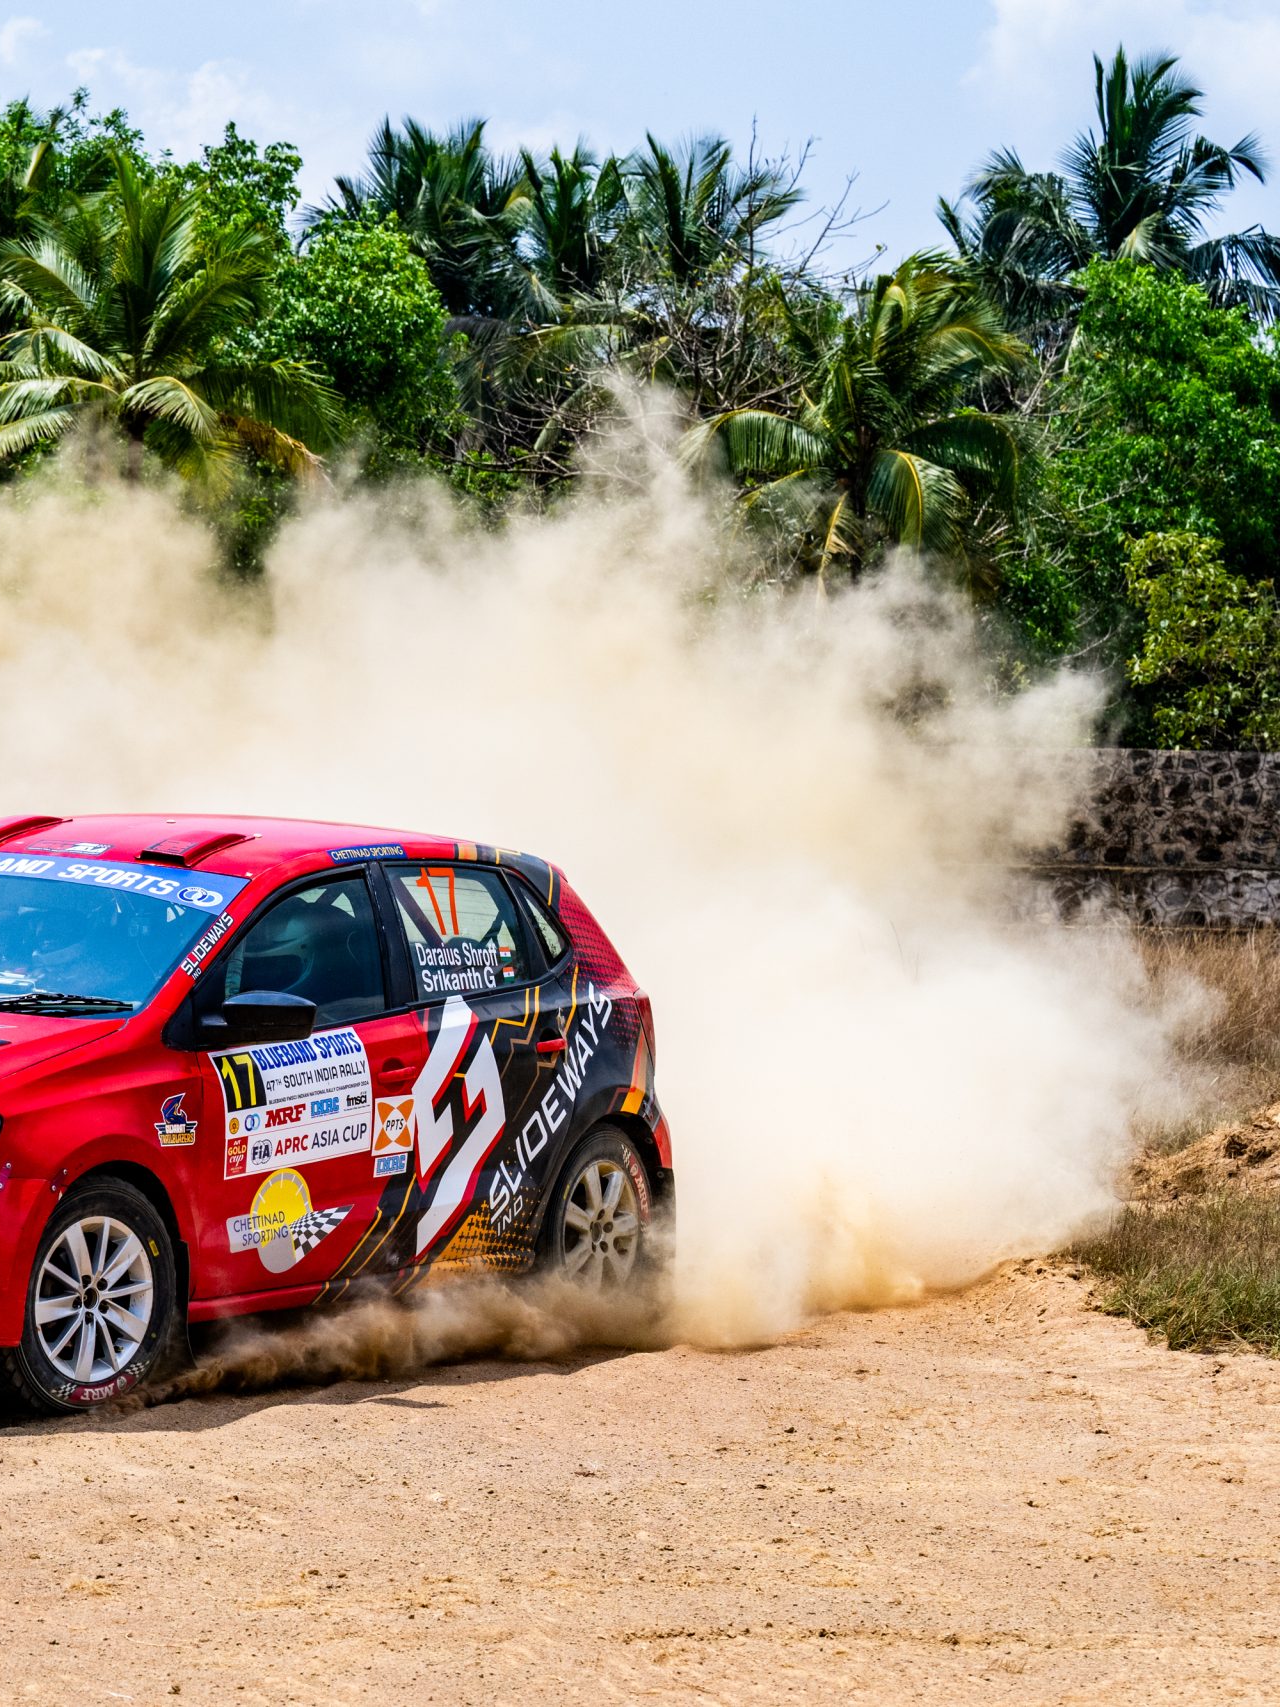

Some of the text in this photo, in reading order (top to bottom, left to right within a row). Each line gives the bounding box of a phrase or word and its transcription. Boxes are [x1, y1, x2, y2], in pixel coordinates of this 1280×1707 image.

[331, 846, 403, 860] CHETTINAD SPORTING
[57, 864, 180, 895] SPORTS
[416, 867, 459, 935] 17
[181, 911, 233, 975] SLIDEWAYS
[415, 942, 498, 966] Daraius Shroff
[422, 966, 497, 992] Srikanth G
[252, 1032, 362, 1071] BLUEBAND SPORTS
[221, 1053, 257, 1109] 17
[283, 1071, 313, 1088] SOUTH
[314, 1066, 338, 1083] INDIA
[339, 1060, 366, 1078] RALLY
[265, 1103, 306, 1128] MRF
[489, 981, 612, 1224] SLIDEWAYS
[385, 1118, 404, 1132] PPTS
[228, 1145, 246, 1156] GOLD
[275, 1123, 367, 1156] APRC ASIA CUP
[233, 1211, 286, 1232] CHETTINAD
[242, 1225, 289, 1247] SPORTING
[80, 1382, 115, 1400] MRF
